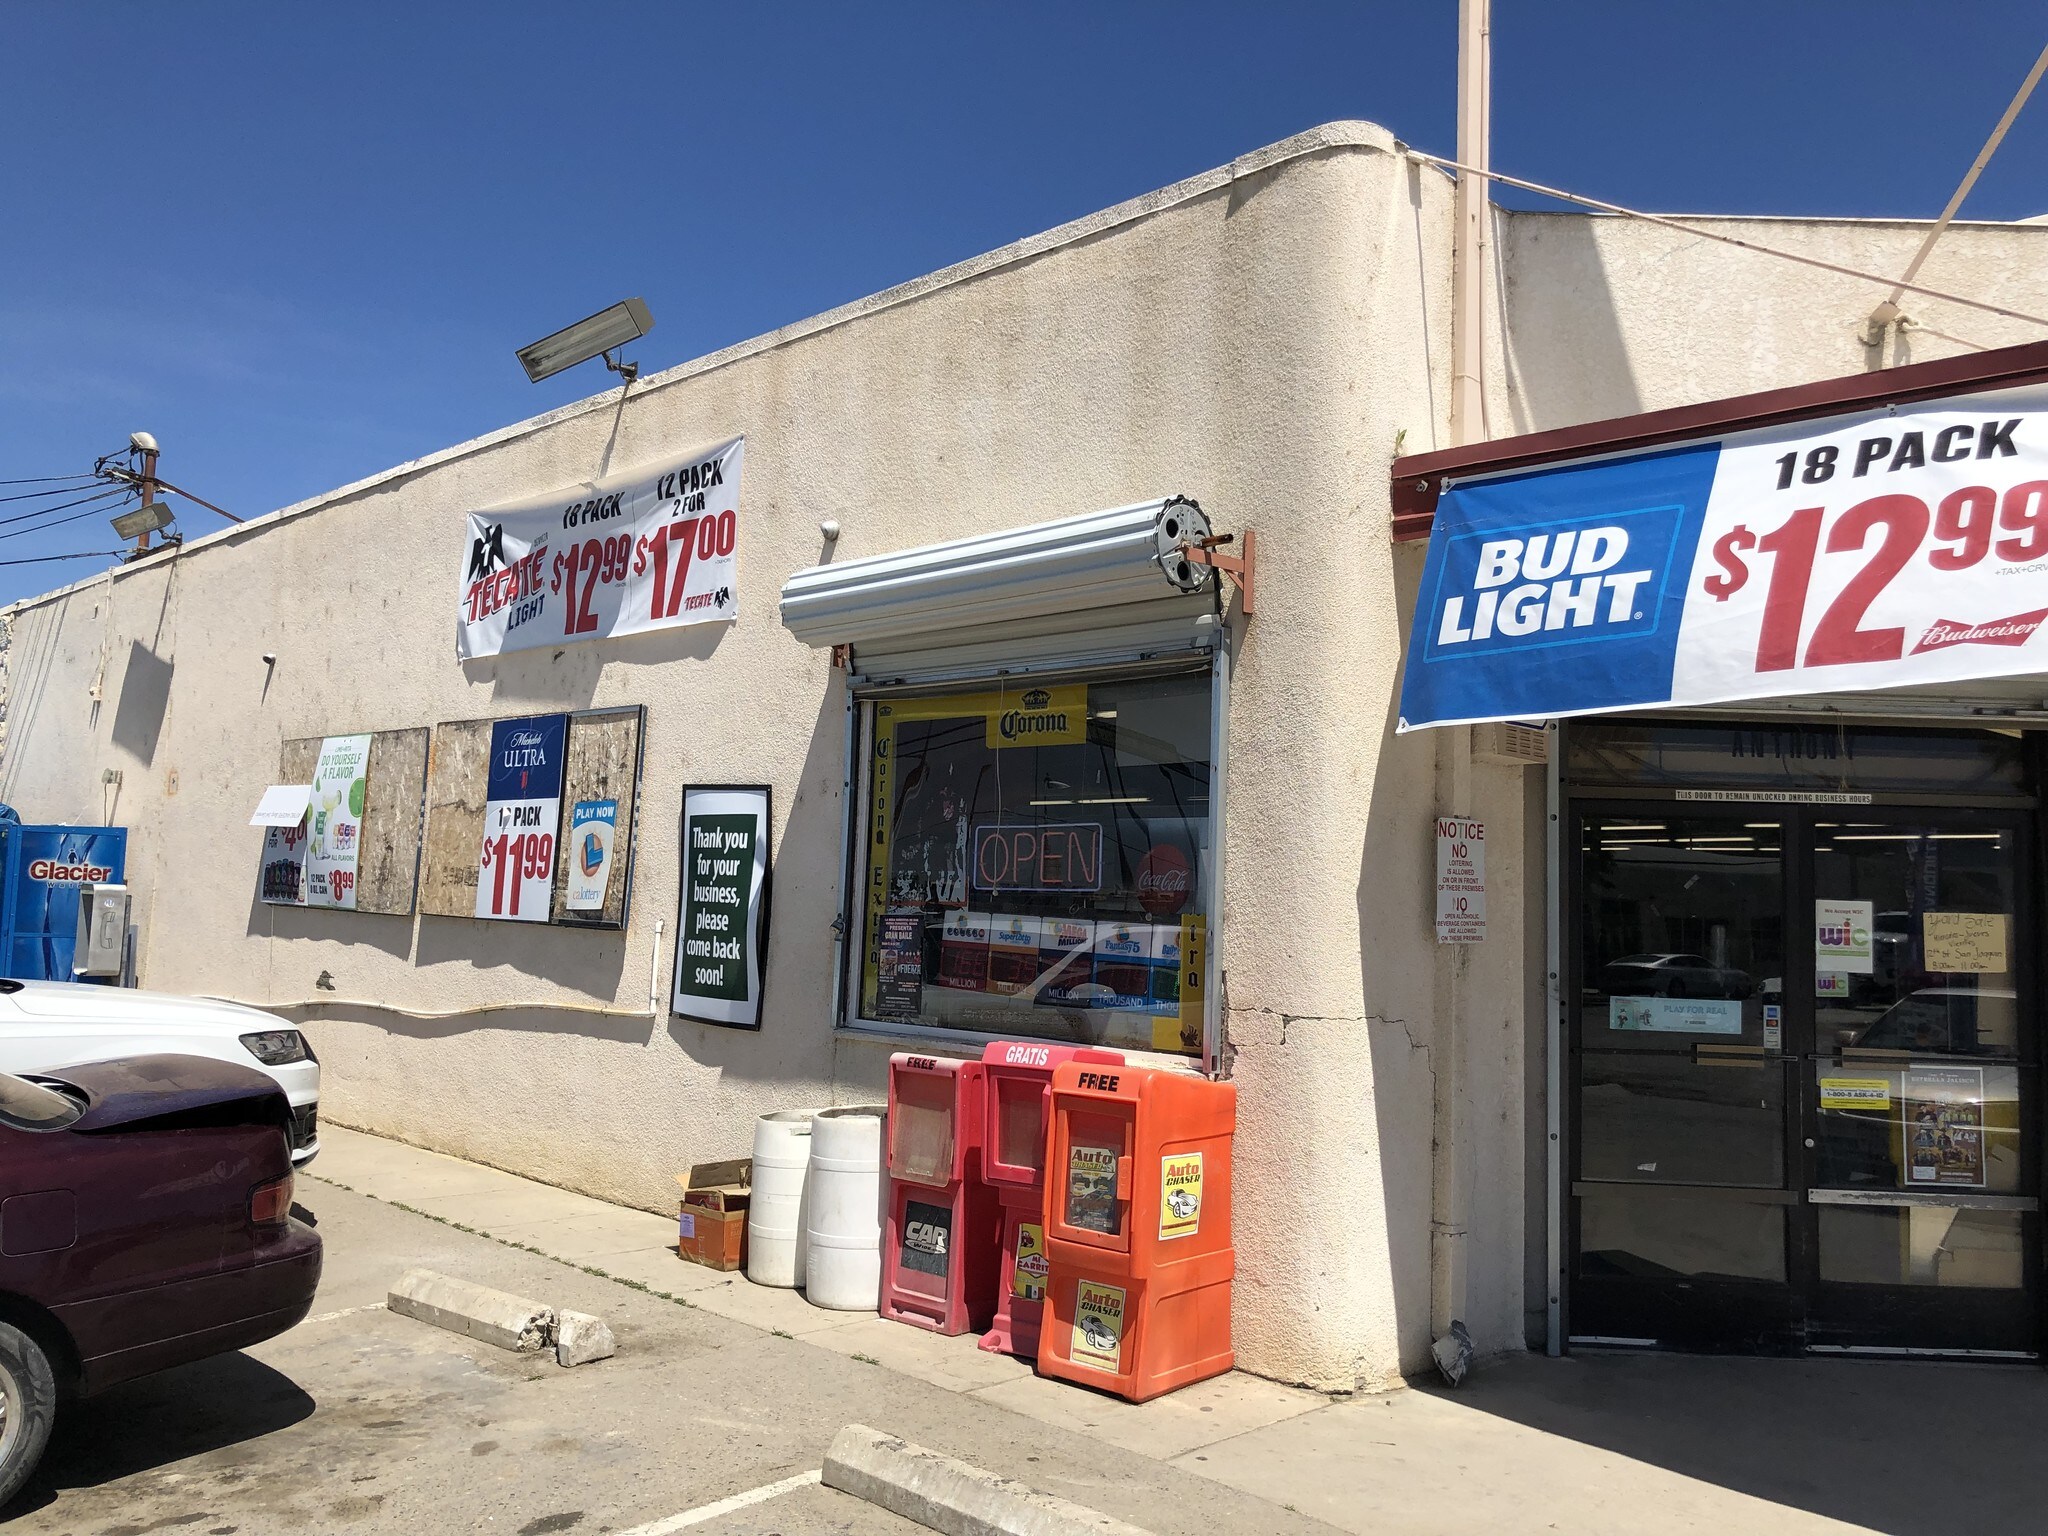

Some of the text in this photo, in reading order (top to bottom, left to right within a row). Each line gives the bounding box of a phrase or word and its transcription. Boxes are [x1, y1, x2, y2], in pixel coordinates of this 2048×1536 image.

[1775, 418, 2024, 491] 18 PACK
[656, 459, 724, 501] 12 PACK
[563, 491, 626, 529] 18 PACK
[672, 492, 705, 517] 2 FOR
[1474, 526, 1629, 591] BUD
[463, 545, 548, 626] TECATE
[684, 593, 714, 611] TECATE
[1437, 570, 1652, 646] LIGHT
[507, 594, 545, 633] LIGHT
[1921, 619, 2040, 646] Budweiser
[1000, 710, 1070, 740] Corona
[321, 753, 362, 766] DO YOURSELF
[504, 748, 546, 768] ULTRA
[322, 766, 354, 780] A FLAVOR
[876, 737, 891, 846] Corona
[1714, 792, 1723, 800] TO
[1726, 792, 1750, 801] REMAIN
[1752, 793, 1786, 801] UNLOCKED
[1815, 794, 1847, 803] BUSINESS
[1849, 795, 1871, 803] HOURS
[513, 806, 541, 827] PACK
[576, 806, 614, 820] PLAY NOW
[693, 827, 748, 854] Thank you
[1439, 821, 1484, 840] NOTICE
[268, 839, 278, 848] FOR
[1452, 843, 1468, 859] NO
[697, 853, 740, 881] for your
[978, 831, 1098, 885] OPEN
[30, 860, 112, 882] Glacier
[316, 874, 326, 883] PACK
[1138, 869, 1189, 892] Coca-Cola
[693, 880, 740, 907] business,
[696, 908, 729, 934] please
[1819, 920, 1869, 946] wic
[686, 935, 741, 960] come back
[695, 964, 724, 986] soon!
[949, 977, 977, 989] MILLION
[1818, 976, 1846, 989] wic
[1048, 988, 1079, 1001] MILLION
[1098, 994, 1143, 1008] THOUSAND
[1664, 1005, 1728, 1015] PLAY FOR REAL
[906, 1056, 937, 1071] FREE
[1005, 1045, 1050, 1066] GRATIS
[1078, 1072, 1120, 1093] FREE
[1071, 1149, 1113, 1166] Auto
[1165, 1173, 1201, 1187] CHASER
[1166, 1162, 1200, 1178] Auto
[906, 1220, 948, 1247] CAR
[1018, 1260, 1049, 1272] CARRIT
[1081, 1288, 1121, 1309] Auto
[1080, 1302, 1121, 1318] CHASER
